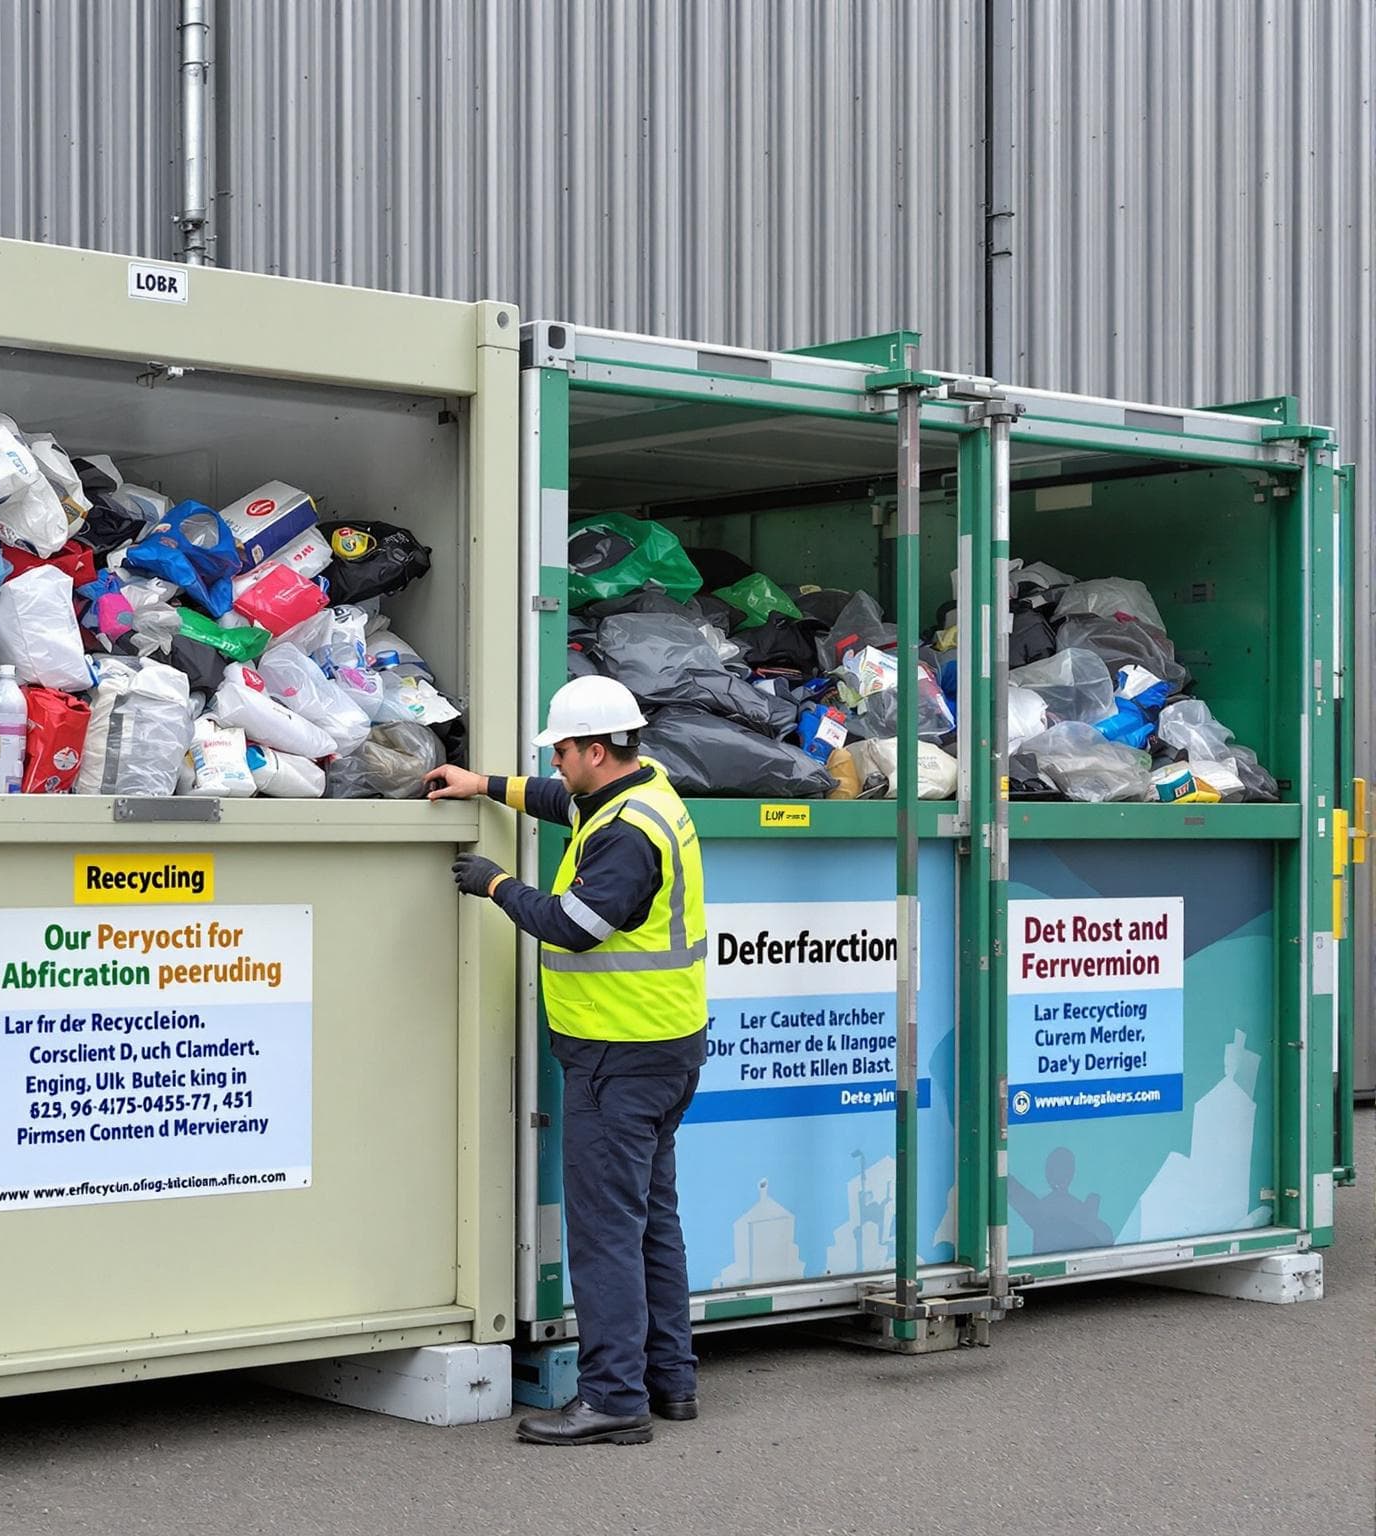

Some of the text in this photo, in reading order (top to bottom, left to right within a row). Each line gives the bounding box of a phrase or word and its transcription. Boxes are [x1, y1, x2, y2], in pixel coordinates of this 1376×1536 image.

[137, 273, 177, 293] LOBR
[87, 865, 204, 893] Reecycling
[45, 922, 243, 954] Our Peryocti for
[1025, 914, 1167, 944] Det Rost and
[2, 956, 281, 989] Abficration peeruding
[1022, 949, 1159, 979] Ferrvermion
[741, 1013, 767, 1029] Ler
[771, 1009, 825, 1028] Cauted
[1035, 1005, 1059, 1021] Lar
[5, 1016, 33, 1034] Lar
[1091, 1025, 1145, 1043] Merder,
[30, 1038, 259, 1064] Corsclient D, uch Clamdert.
[805, 1035, 823, 1052] de
[741, 1064, 767, 1080] For
[773, 1062, 806, 1078] Rott
[853, 1057, 893, 1074] Blast.
[1085, 1051, 1146, 1072] Derrige!
[26, 1074, 91, 1096] Enging,
[191, 1068, 226, 1088] king
[232, 1067, 246, 1084] in
[223, 1091, 252, 1108] 451
[18, 1127, 85, 1145] Pirmsen
[159, 1120, 169, 1137] d
